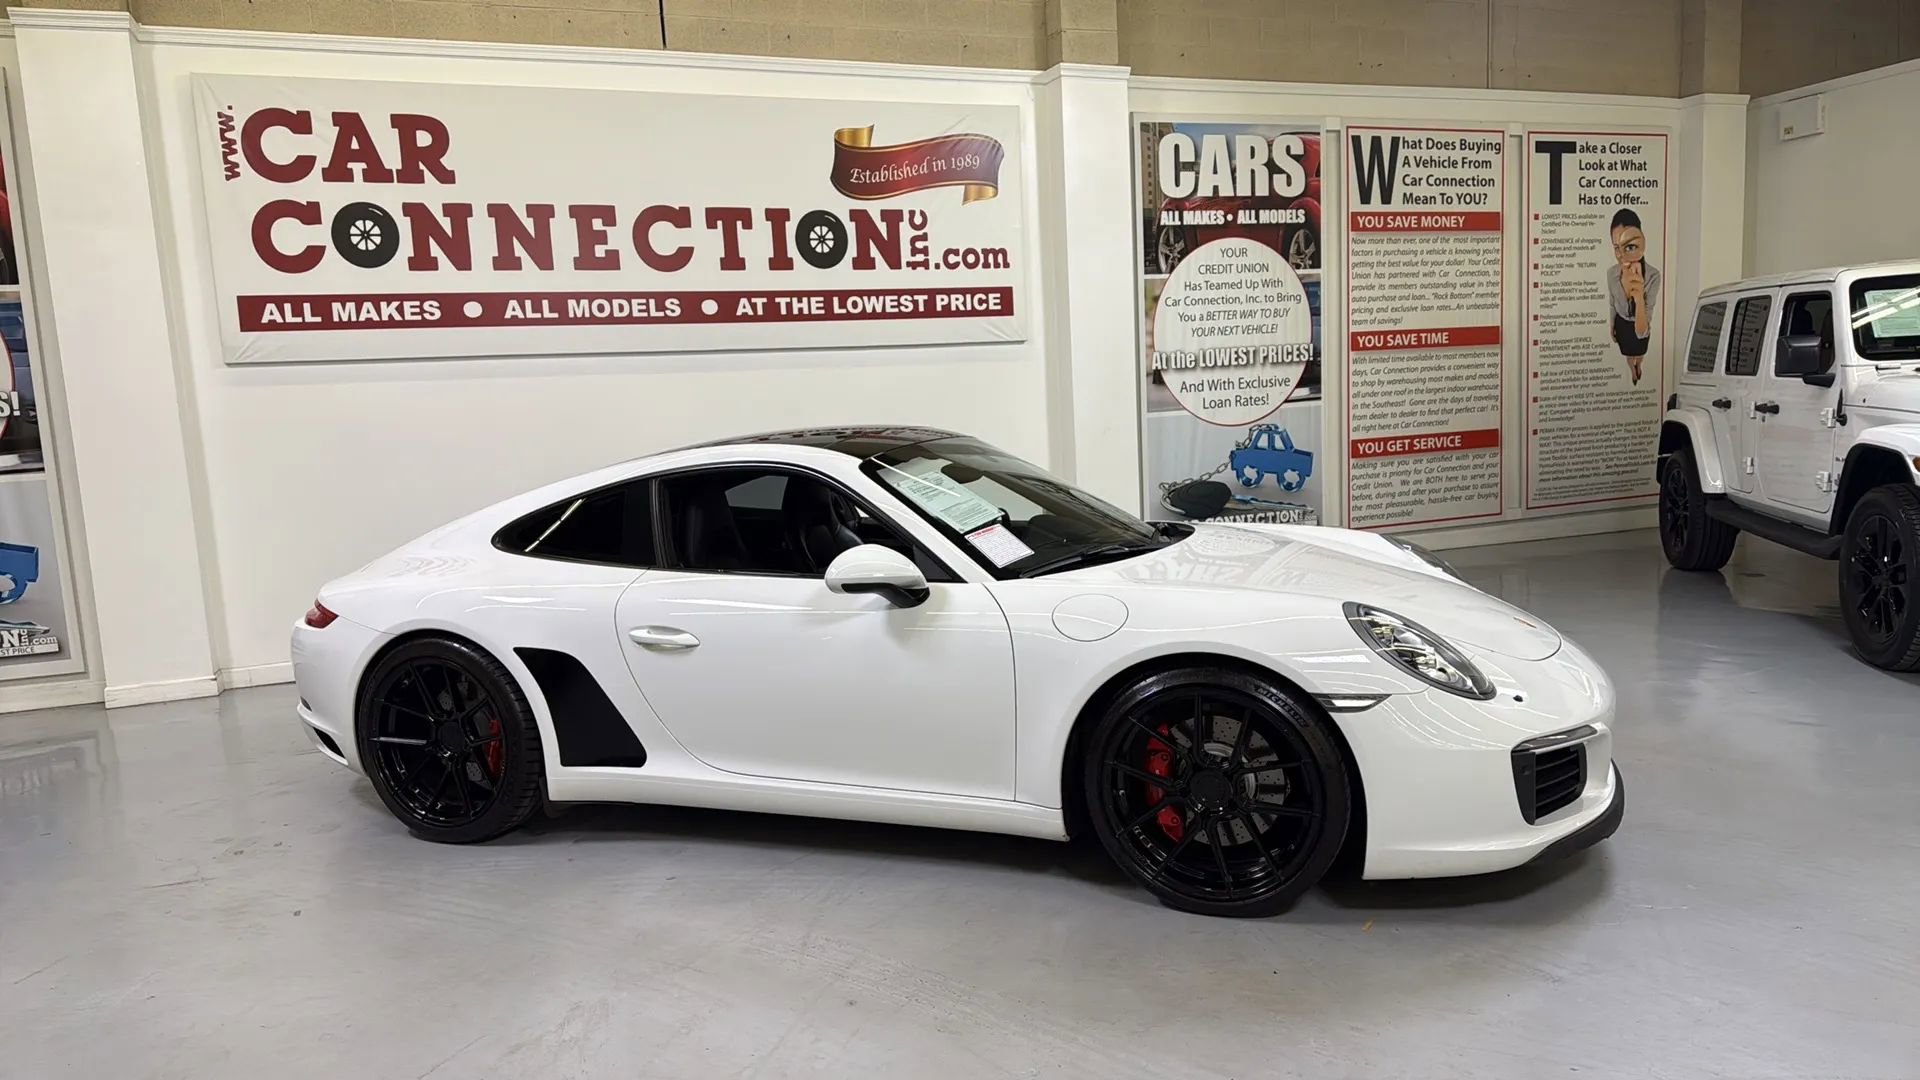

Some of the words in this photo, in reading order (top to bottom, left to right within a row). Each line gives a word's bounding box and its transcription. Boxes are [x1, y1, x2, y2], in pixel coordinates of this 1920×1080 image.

[240, 107, 456, 184] CAR
[1426, 137, 1456, 150] Does
[1459, 139, 1501, 155] Buying
[1600, 144, 1606, 154] a
[1609, 142, 1642, 154] Closer
[849, 157, 929, 184] Established
[932, 157, 947, 172] in
[950, 154, 980, 170] 1989
[1158, 133, 1306, 199] CARS
[1402, 156, 1411, 168] A
[1414, 156, 1458, 169] Vehicle
[1461, 157, 1492, 169] From
[1578, 159, 1605, 171] Look
[1607, 160, 1618, 171] at
[1620, 159, 1648, 171] What
[1402, 174, 1423, 187] Car
[1426, 174, 1495, 187] Connection
[1578, 176, 1596, 188] Car
[1599, 176, 1658, 188] Connection
[1402, 192, 1437, 205] Mean
[1439, 193, 1454, 205] To
[1456, 193, 1488, 205] YOU?
[1578, 193, 1599, 205] Has
[1600, 194, 1612, 205] to
[1614, 193, 1649, 205] Offer...
[1160, 210, 1181, 226] ALL
[1183, 210, 1225, 226] MAKES
[1237, 209, 1257, 224] ALL
[1259, 209, 1306, 224] MODELS
[1357, 216, 1384, 228] YOU
[1387, 216, 1418, 228] SAVE
[1421, 216, 1465, 228] MONEY
[251, 199, 904, 274] CONNECTION
[934, 246, 1011, 271] .com
[1220, 247, 1248, 258] YOUR
[1382, 249, 1418, 258] purchasing
[1455, 247, 1480, 256] knowing
[1198, 264, 1234, 275] CREDIT
[1236, 263, 1269, 274] UNION
[1374, 271, 1386, 279] has
[1388, 271, 1420, 281] partnered
[1422, 270, 1436, 278] with
[1439, 270, 1449, 278] Car
[1184, 281, 1202, 292] Has
[1204, 279, 1243, 291] Teamed
[1245, 279, 1259, 291] Up
[1261, 277, 1283, 288] With
[1351, 283, 1375, 292] provide
[1388, 283, 1417, 291] members
[1420, 281, 1457, 291] outstanding
[1459, 281, 1475, 289] value
[1165, 297, 1181, 307] Car
[1183, 294, 1243, 306] Connection,
[1245, 294, 1262, 304] Inc.
[1264, 294, 1275, 303] to
[1276, 292, 1301, 305] Bring
[260, 302, 322, 324] ALL
[331, 300, 442, 322] MAKES
[504, 299, 559, 319] ALL
[567, 298, 682, 319] MODELS
[736, 297, 767, 316] AT
[775, 296, 825, 315] THE
[833, 294, 928, 314] LOWEST
[935, 292, 1002, 312] PRICE
[1178, 312, 1196, 322] You
[1206, 309, 1238, 322] BETTER
[1239, 309, 1258, 320] WAY
[1260, 308, 1272, 318] TO
[1273, 307, 1291, 318] BUY
[1191, 327, 1216, 337] YOUR
[1217, 325, 1240, 336] NEXT
[1241, 323, 1278, 335] VEHICLE!
[1357, 335, 1384, 347] YOU
[1386, 334, 1418, 346] SAVE
[1419, 332, 1449, 344] TIME
[1152, 351, 1168, 370] At
[1170, 350, 1196, 368] the
[1199, 345, 1256, 367] LOWEST
[1259, 343, 1313, 364] PRICES!
[1383, 366, 1419, 375] Connection
[1180, 380, 1204, 393] And
[1207, 378, 1235, 391] With
[1238, 376, 1291, 390] Exclusive
[1361, 379, 1376, 389] shop
[1203, 397, 1231, 409] Loan
[1235, 393, 1269, 407] Rates!
[1361, 423, 1377, 433] right
[1400, 421, 1411, 429] Car
[1357, 442, 1384, 454] YOU
[1386, 440, 1411, 452] GET
[1413, 435, 1462, 450] SERVICE
[1352, 462, 1378, 470] Making
